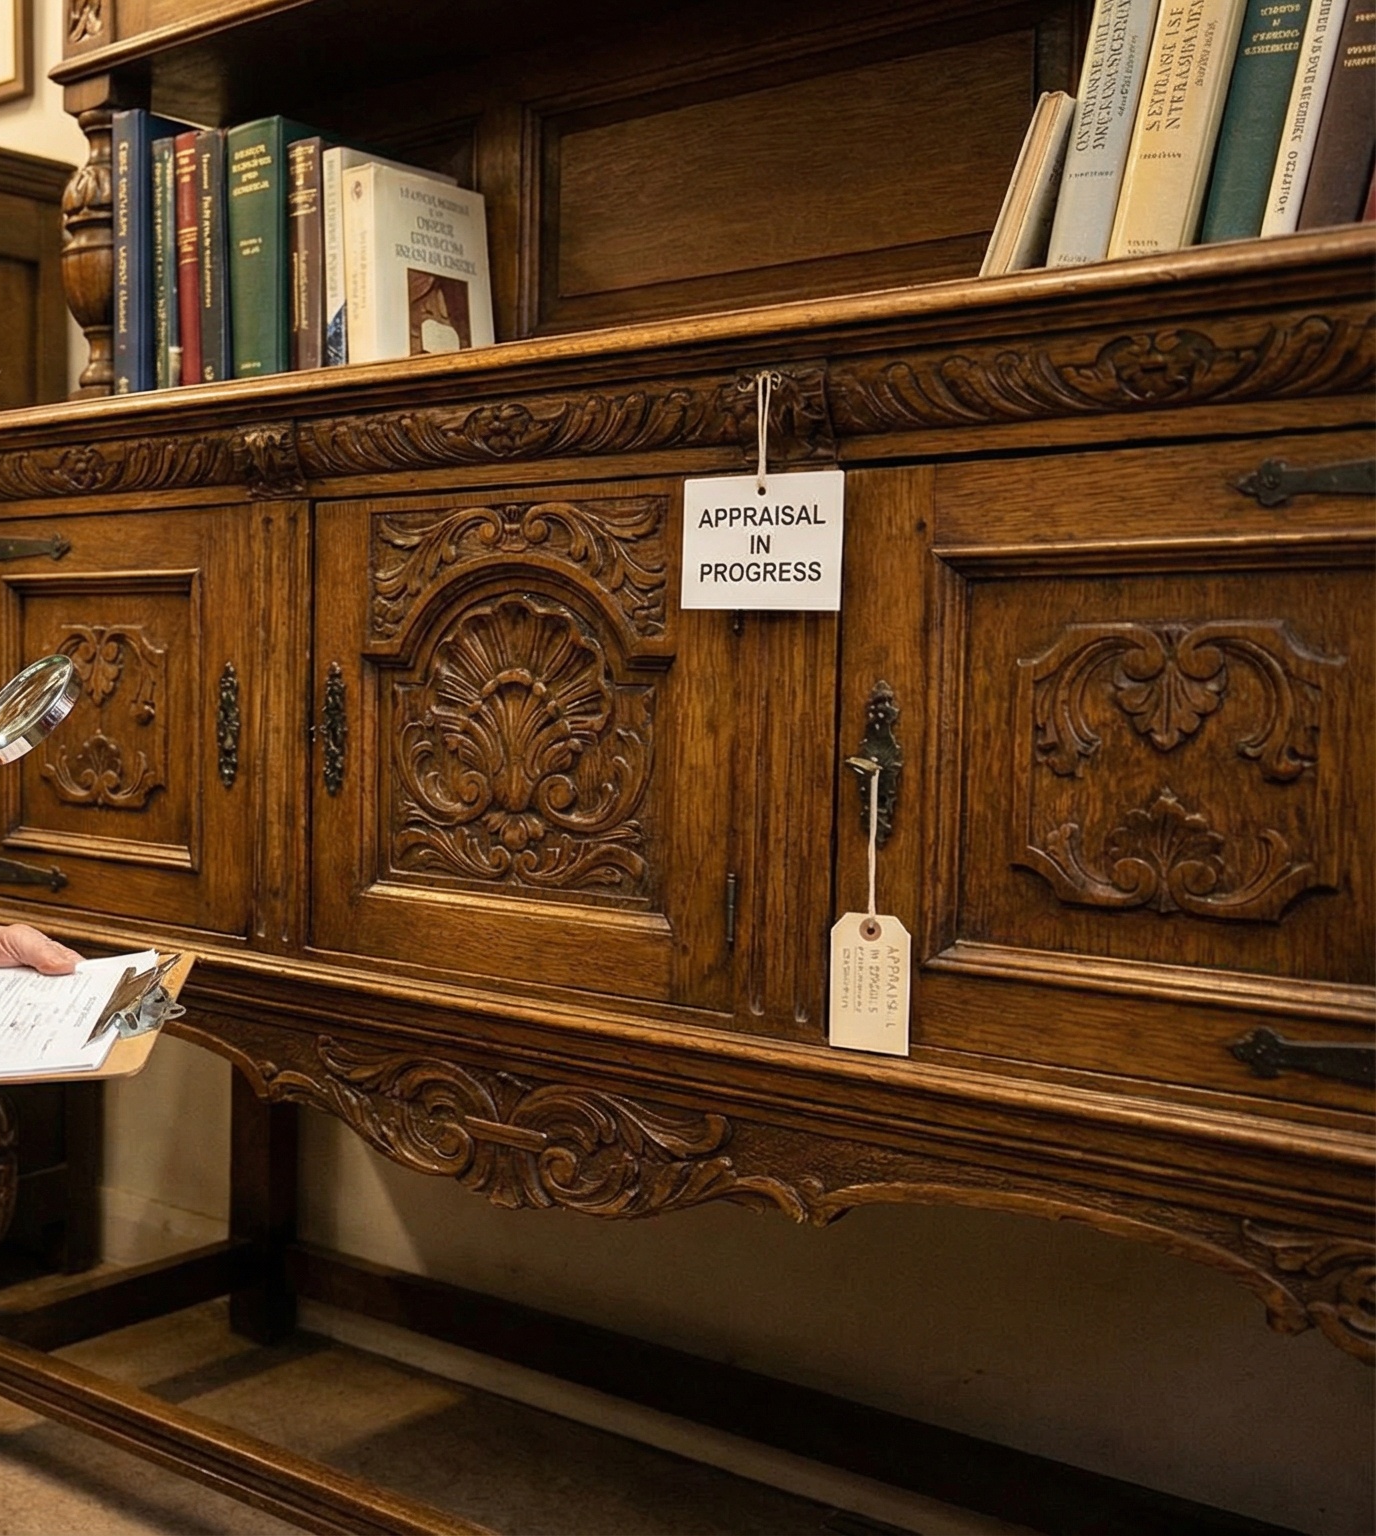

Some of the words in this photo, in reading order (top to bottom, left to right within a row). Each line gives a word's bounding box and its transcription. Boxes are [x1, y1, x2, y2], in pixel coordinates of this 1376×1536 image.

[698, 504, 827, 528] APPRAISAL
[750, 534, 771, 554] IN
[700, 561, 822, 582] PROGRESS
